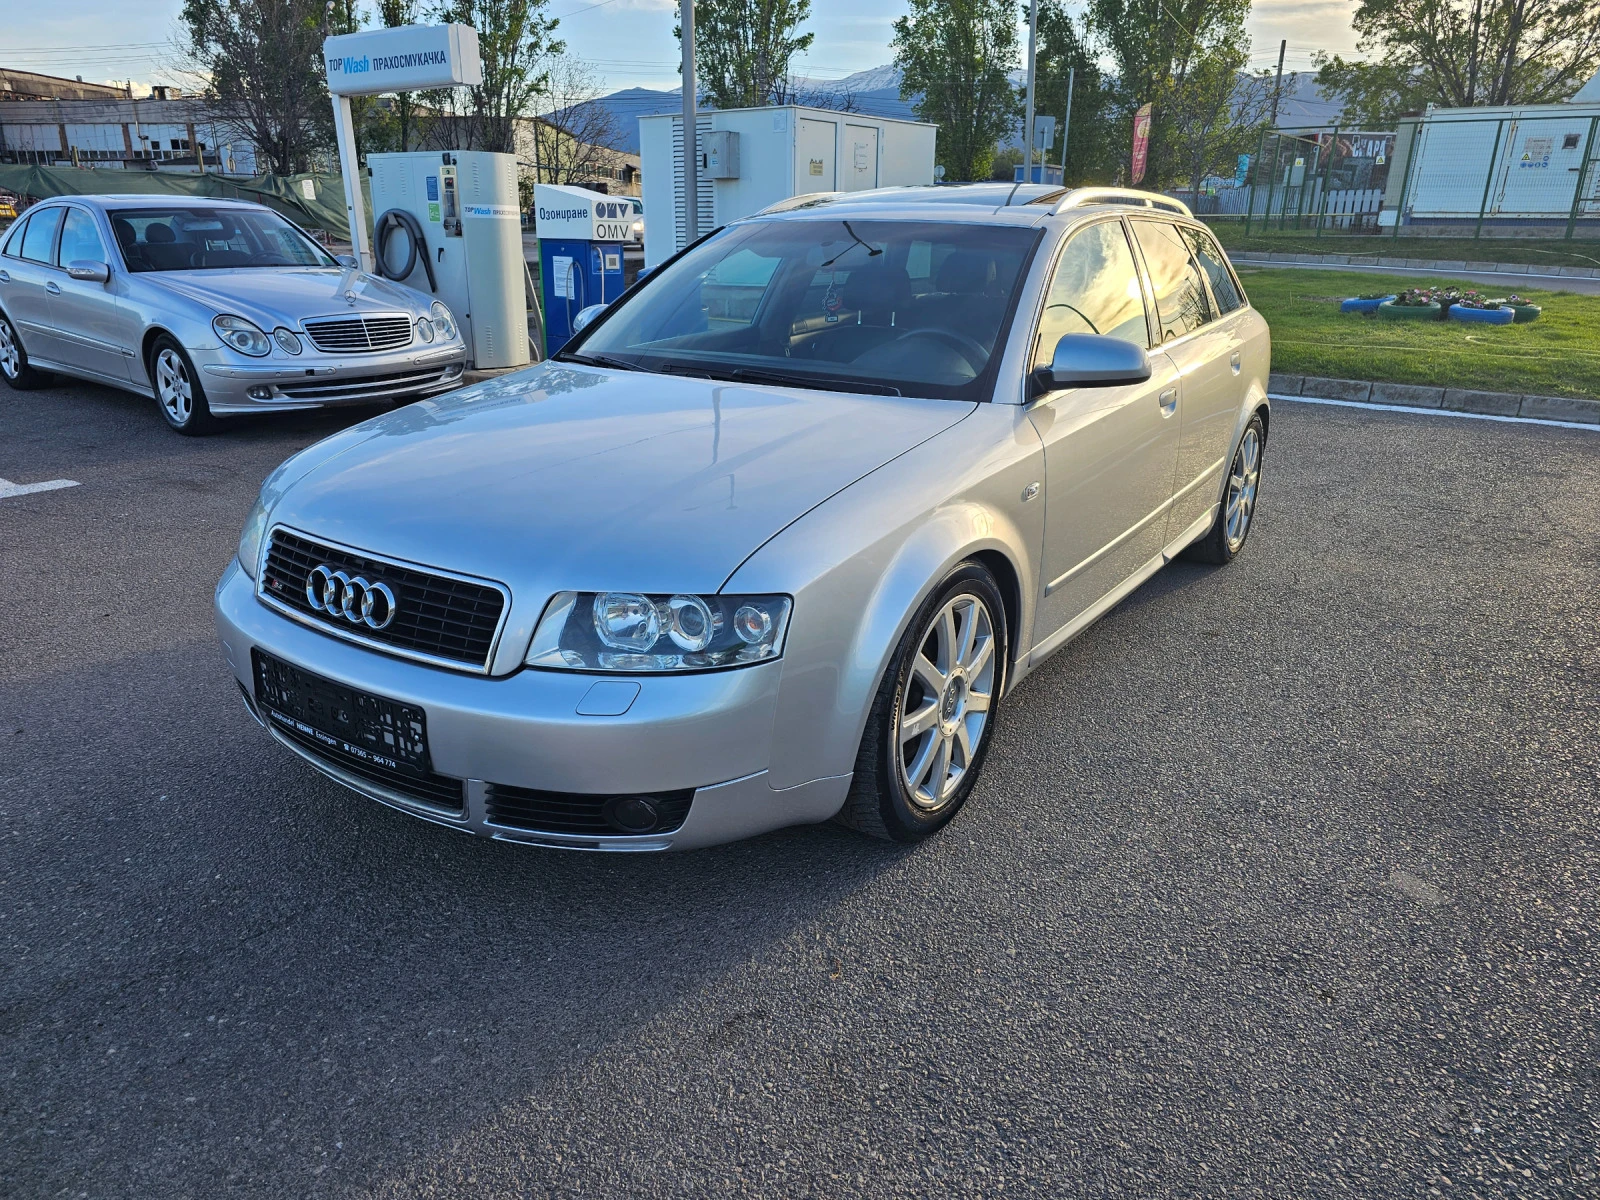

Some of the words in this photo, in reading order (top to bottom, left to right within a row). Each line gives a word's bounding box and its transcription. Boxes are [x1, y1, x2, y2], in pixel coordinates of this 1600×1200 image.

[373, 50, 447, 71] ПРАХОСМУКАЧКА
[539, 207, 588, 222] Озониране
[596, 224, 629, 239] OMV
[271, 710, 294, 726] Autohandel
[296, 722, 314, 735] HENNE
[315, 731, 337, 745] Essingen
[373, 754, 385, 765] 964
[384, 758, 396, 768] 774
